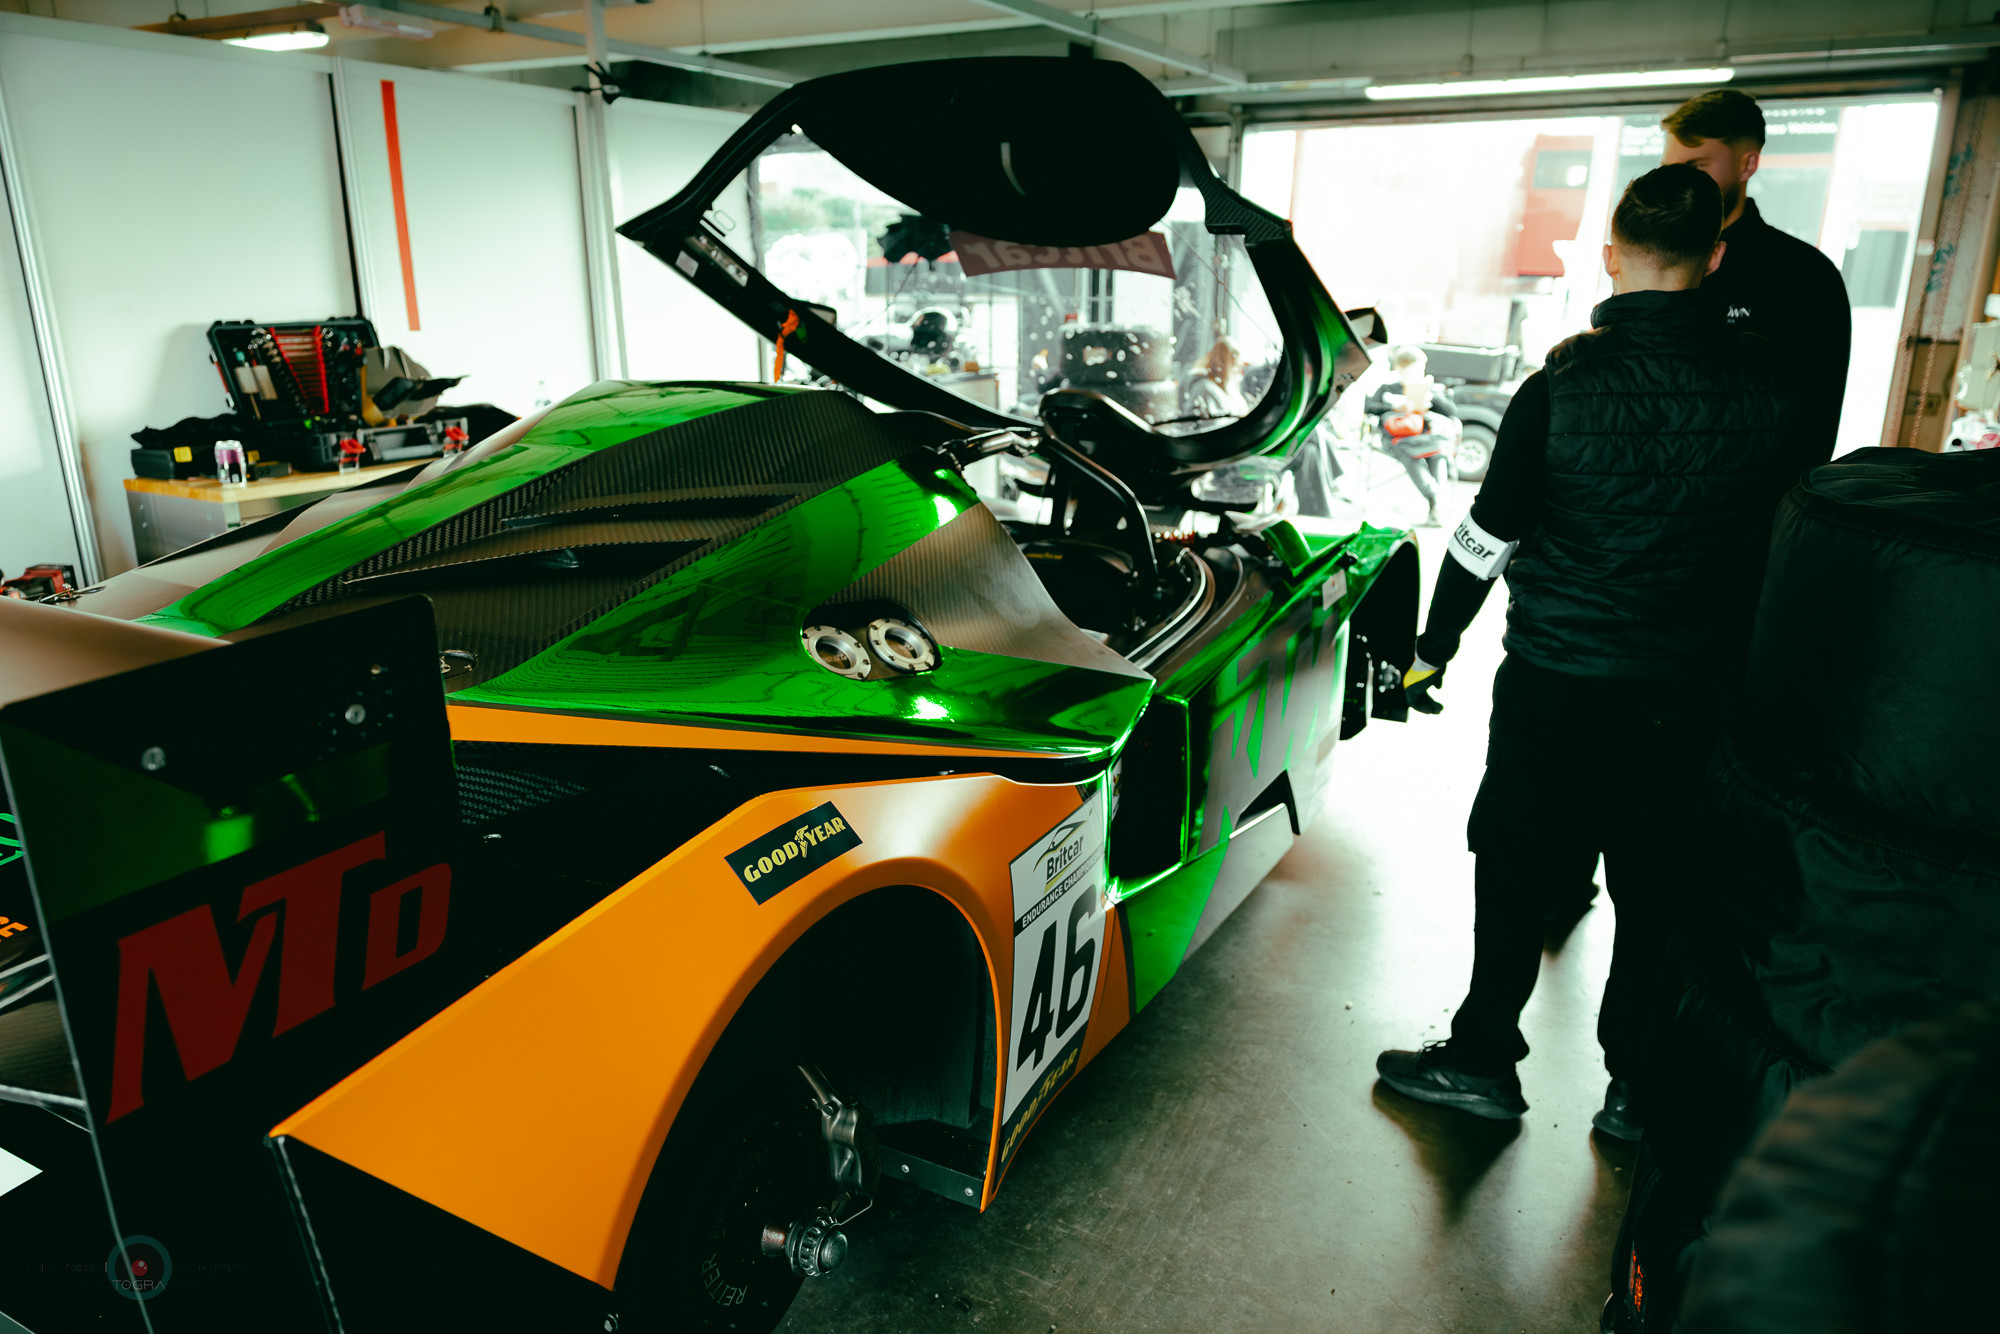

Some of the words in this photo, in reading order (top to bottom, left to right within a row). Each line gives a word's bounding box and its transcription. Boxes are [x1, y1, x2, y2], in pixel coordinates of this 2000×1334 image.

[743, 816, 847, 883] GOODYEAR
[1046, 834, 1085, 881] Britcar
[1021, 886, 1063, 929] ENDURANCE
[105, 830, 452, 1126] MTD
[1016, 883, 1096, 1072] 46
[701, 1252, 748, 1307] REITER
